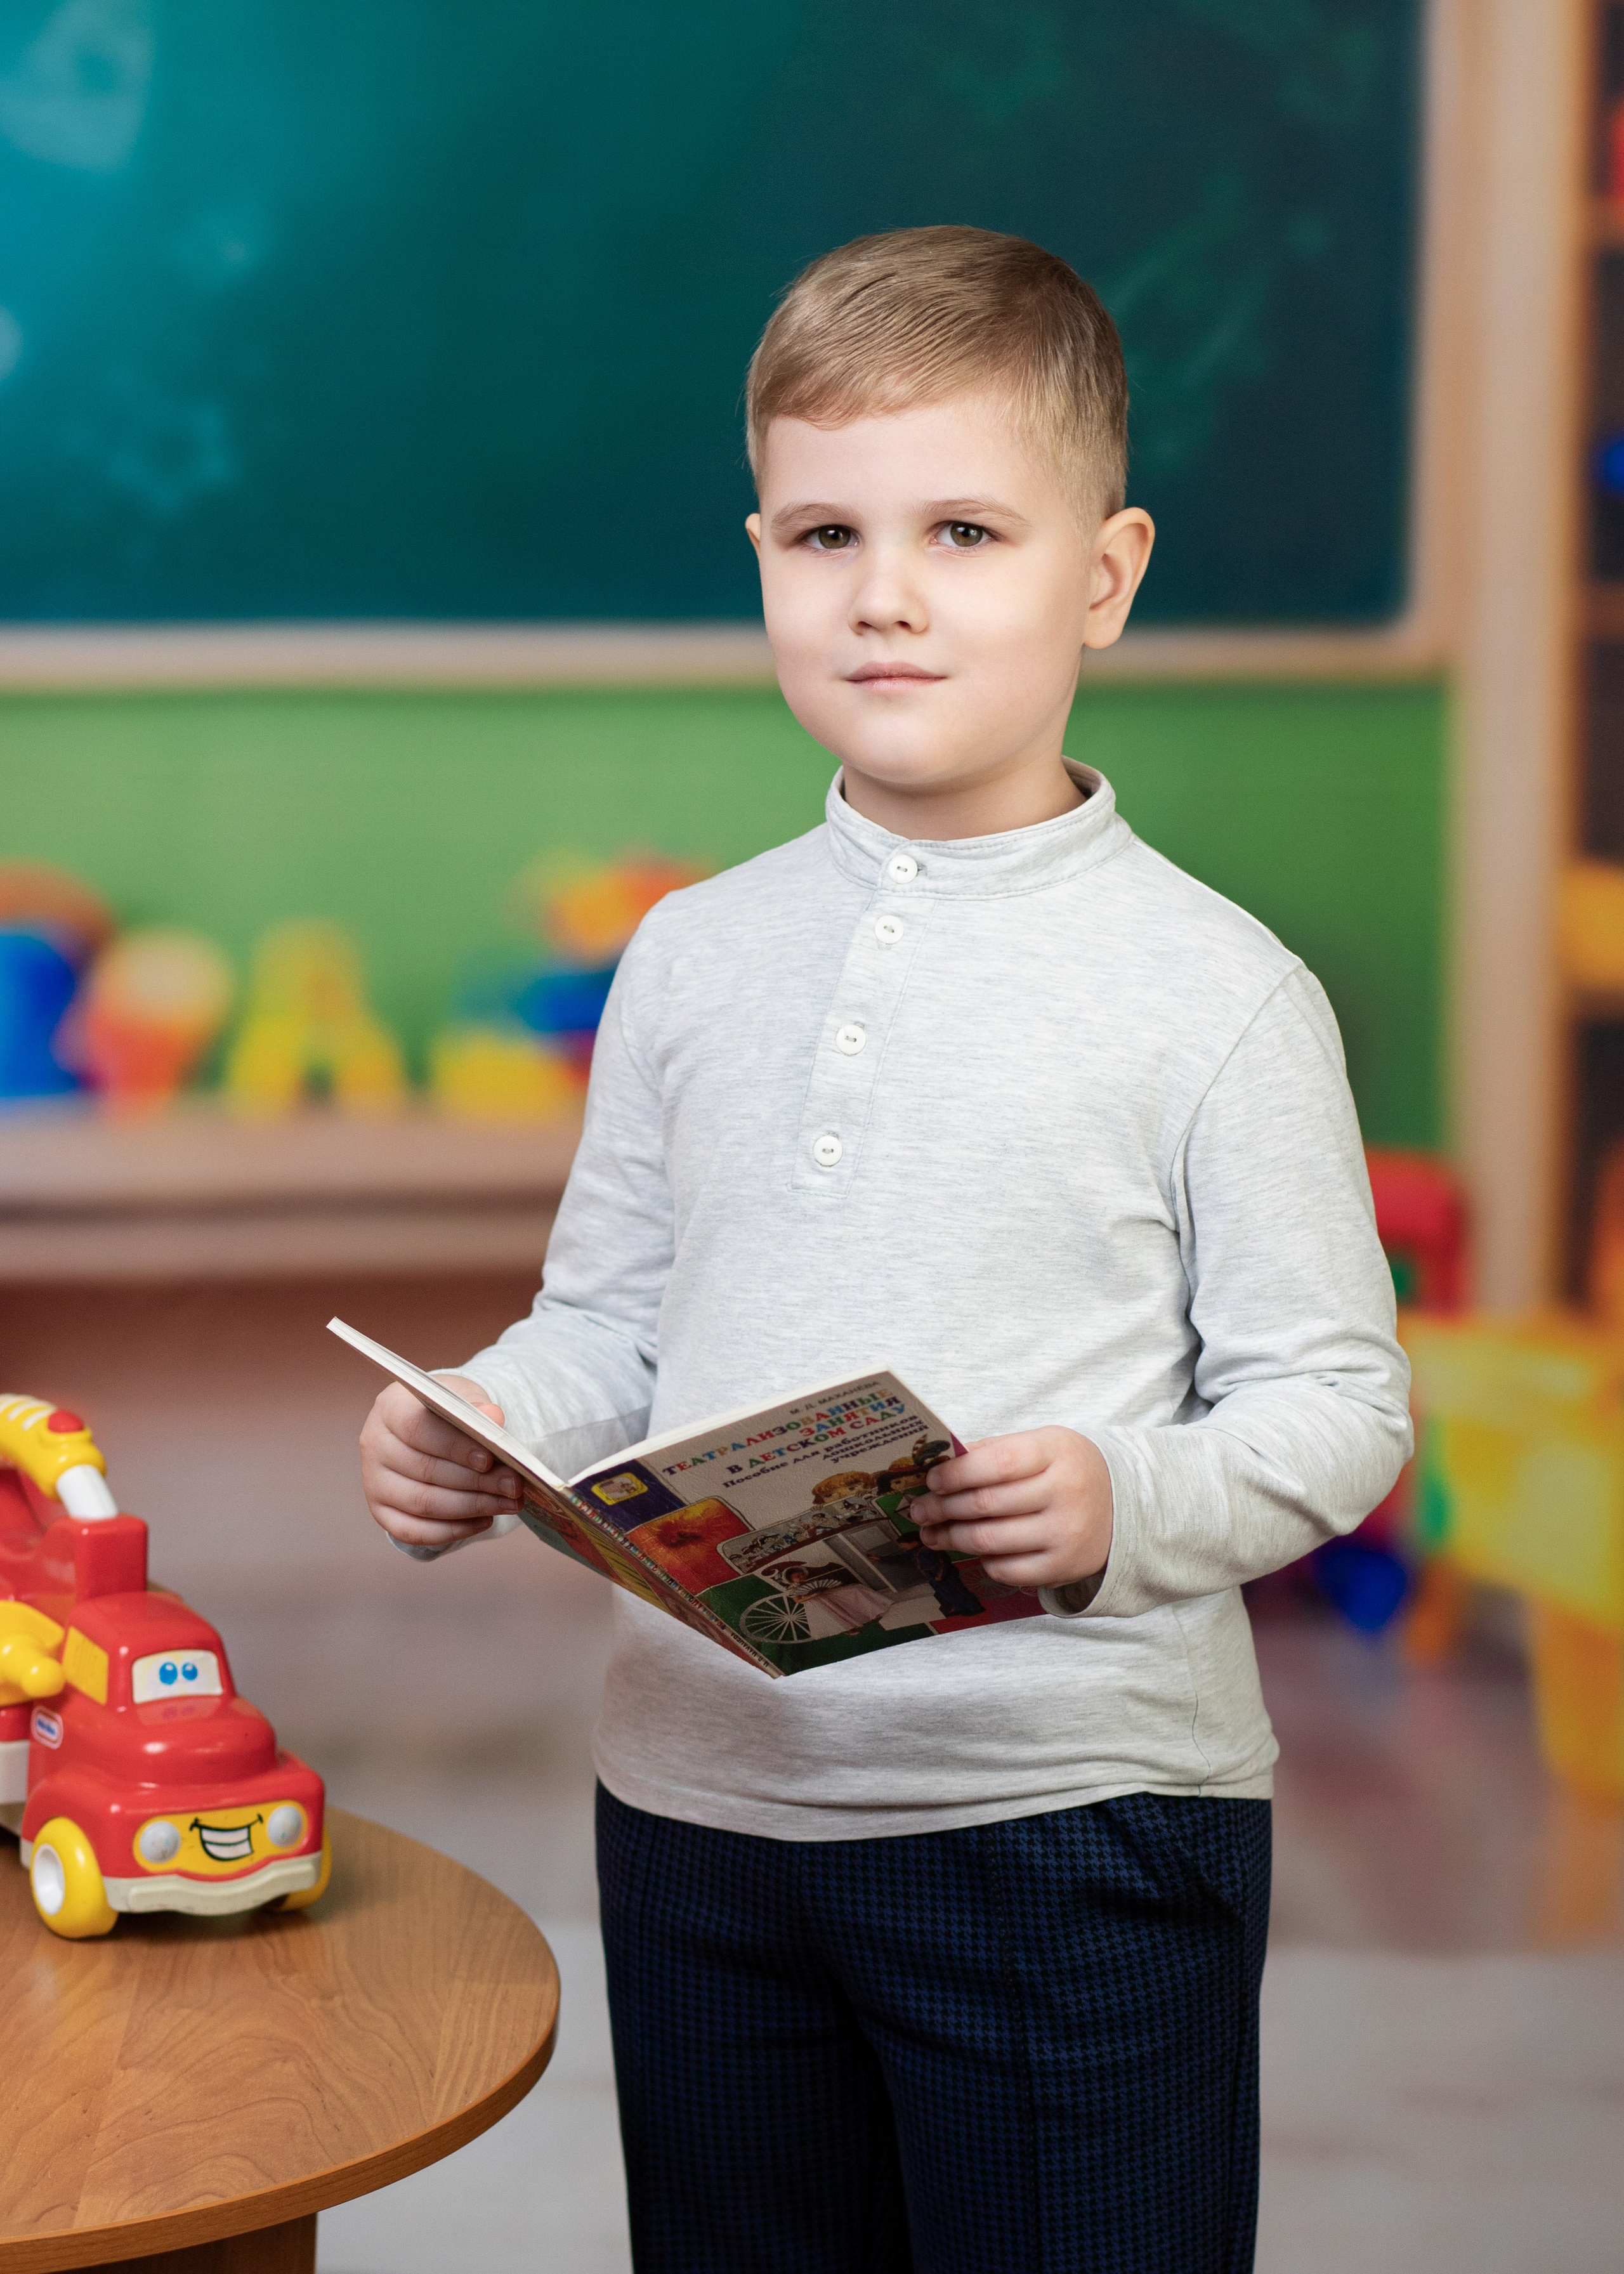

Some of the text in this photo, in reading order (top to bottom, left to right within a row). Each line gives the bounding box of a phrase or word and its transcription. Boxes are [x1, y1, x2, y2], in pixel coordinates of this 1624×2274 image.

[662, 1389, 893, 1475] ТЕАТРАЛИЗОВАННЫЕ
[726, 1403, 905, 1474] В ДЕТСКОМ САДУ
[799, 1396, 901, 1437] ЗАНЯТИЯ
[823, 1420, 923, 1460] дошкольных
[832, 1425, 929, 1463] учреждений
[723, 1415, 919, 1488] Пособие для работников
